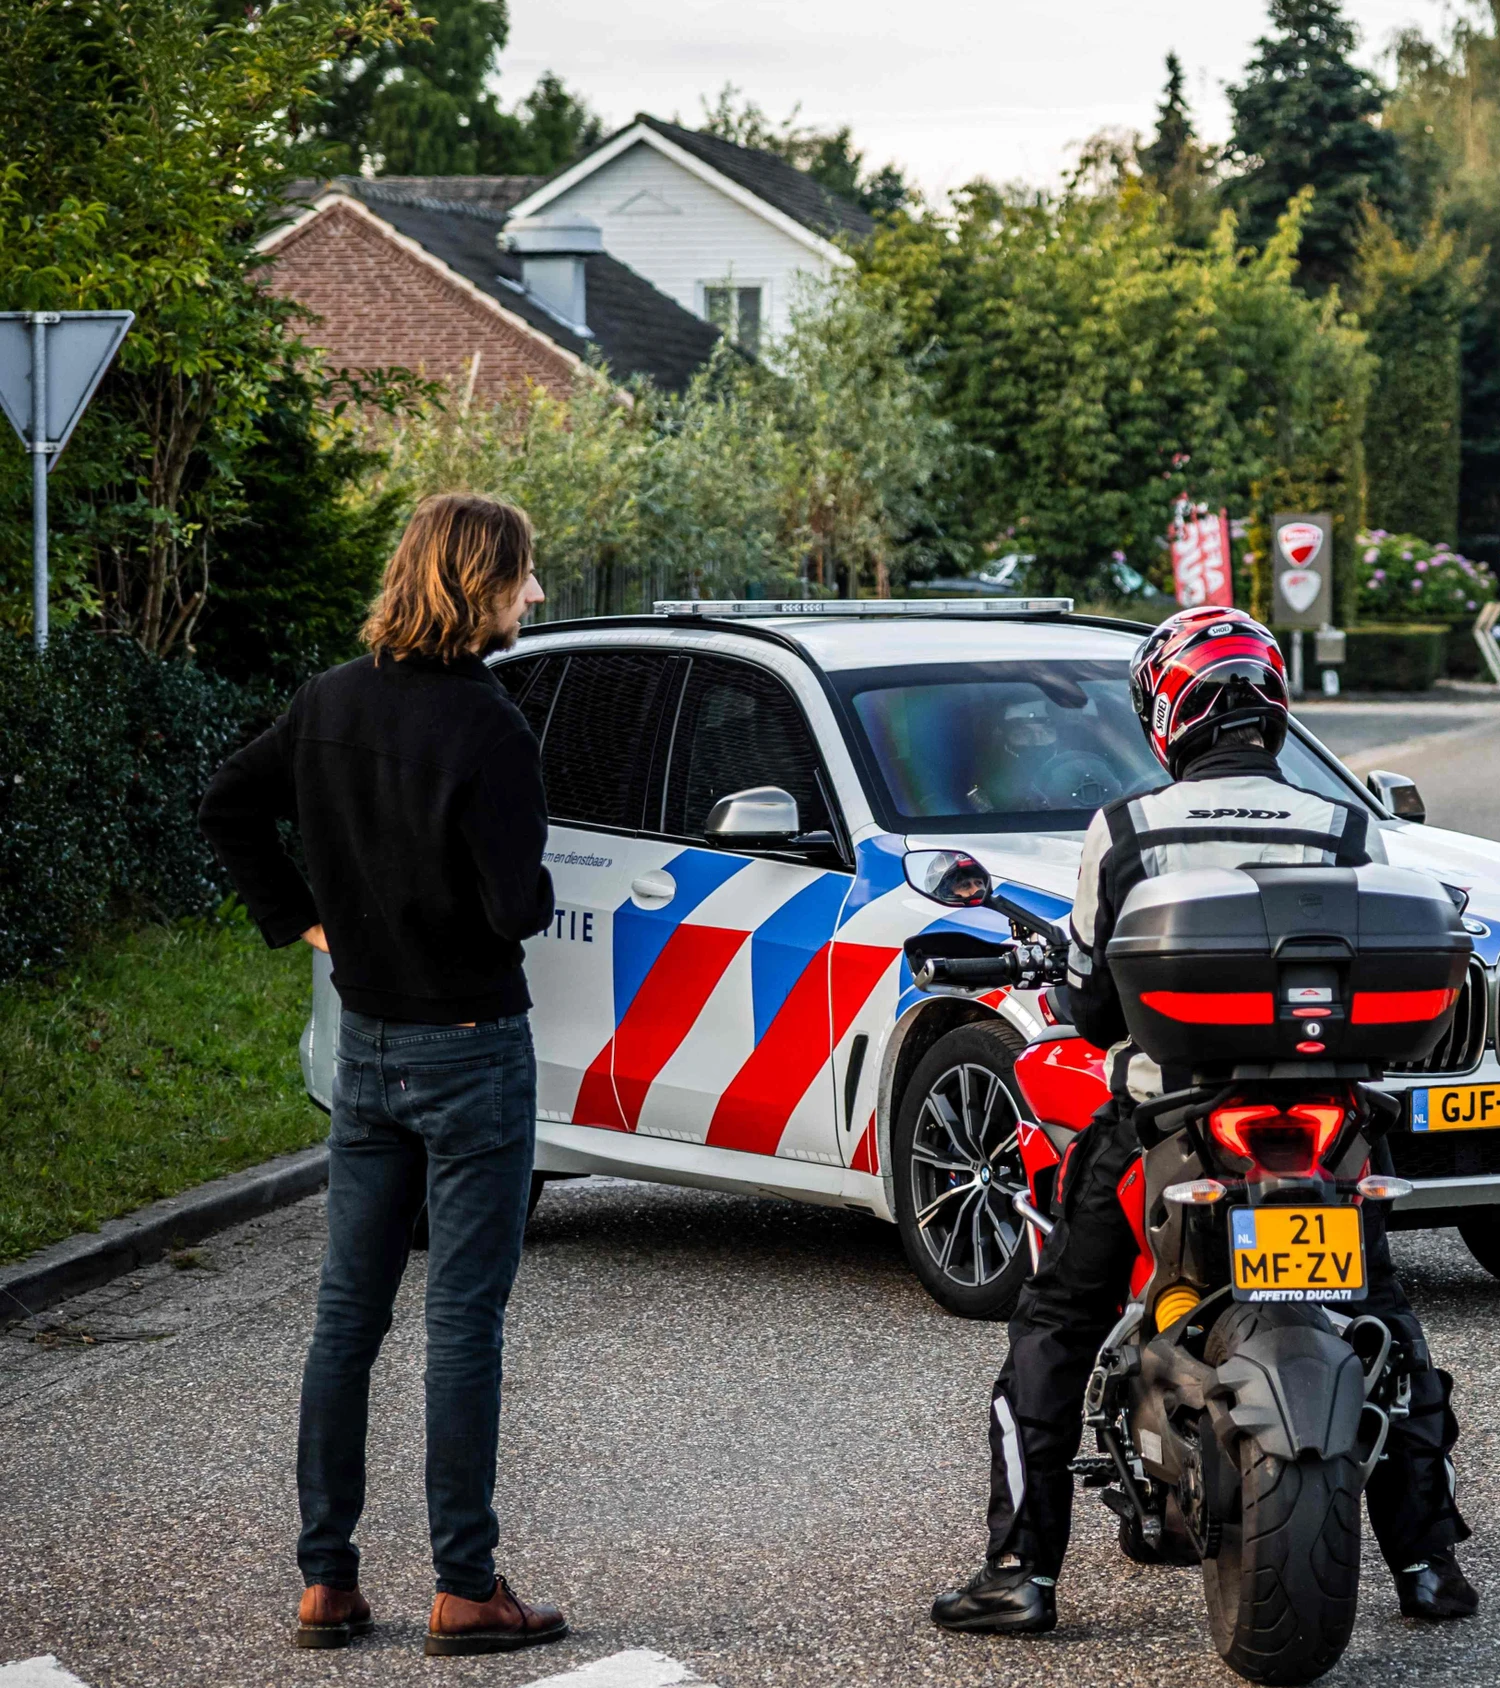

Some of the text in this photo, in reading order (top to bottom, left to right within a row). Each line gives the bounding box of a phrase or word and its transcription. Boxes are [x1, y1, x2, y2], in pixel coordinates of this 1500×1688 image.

[1212, 626, 1230, 634] SHOEI
[1156, 699, 1167, 732] SHOEI
[1185, 808, 1291, 819] SPIDI
[1414, 1114, 1426, 1124] NL
[1289, 1214, 1325, 1244] 21
[1238, 1234, 1252, 1244] NL
[1241, 1252, 1352, 1283] MF-ZV
[1249, 1290, 1352, 1301] AFFETTO DUCATI
